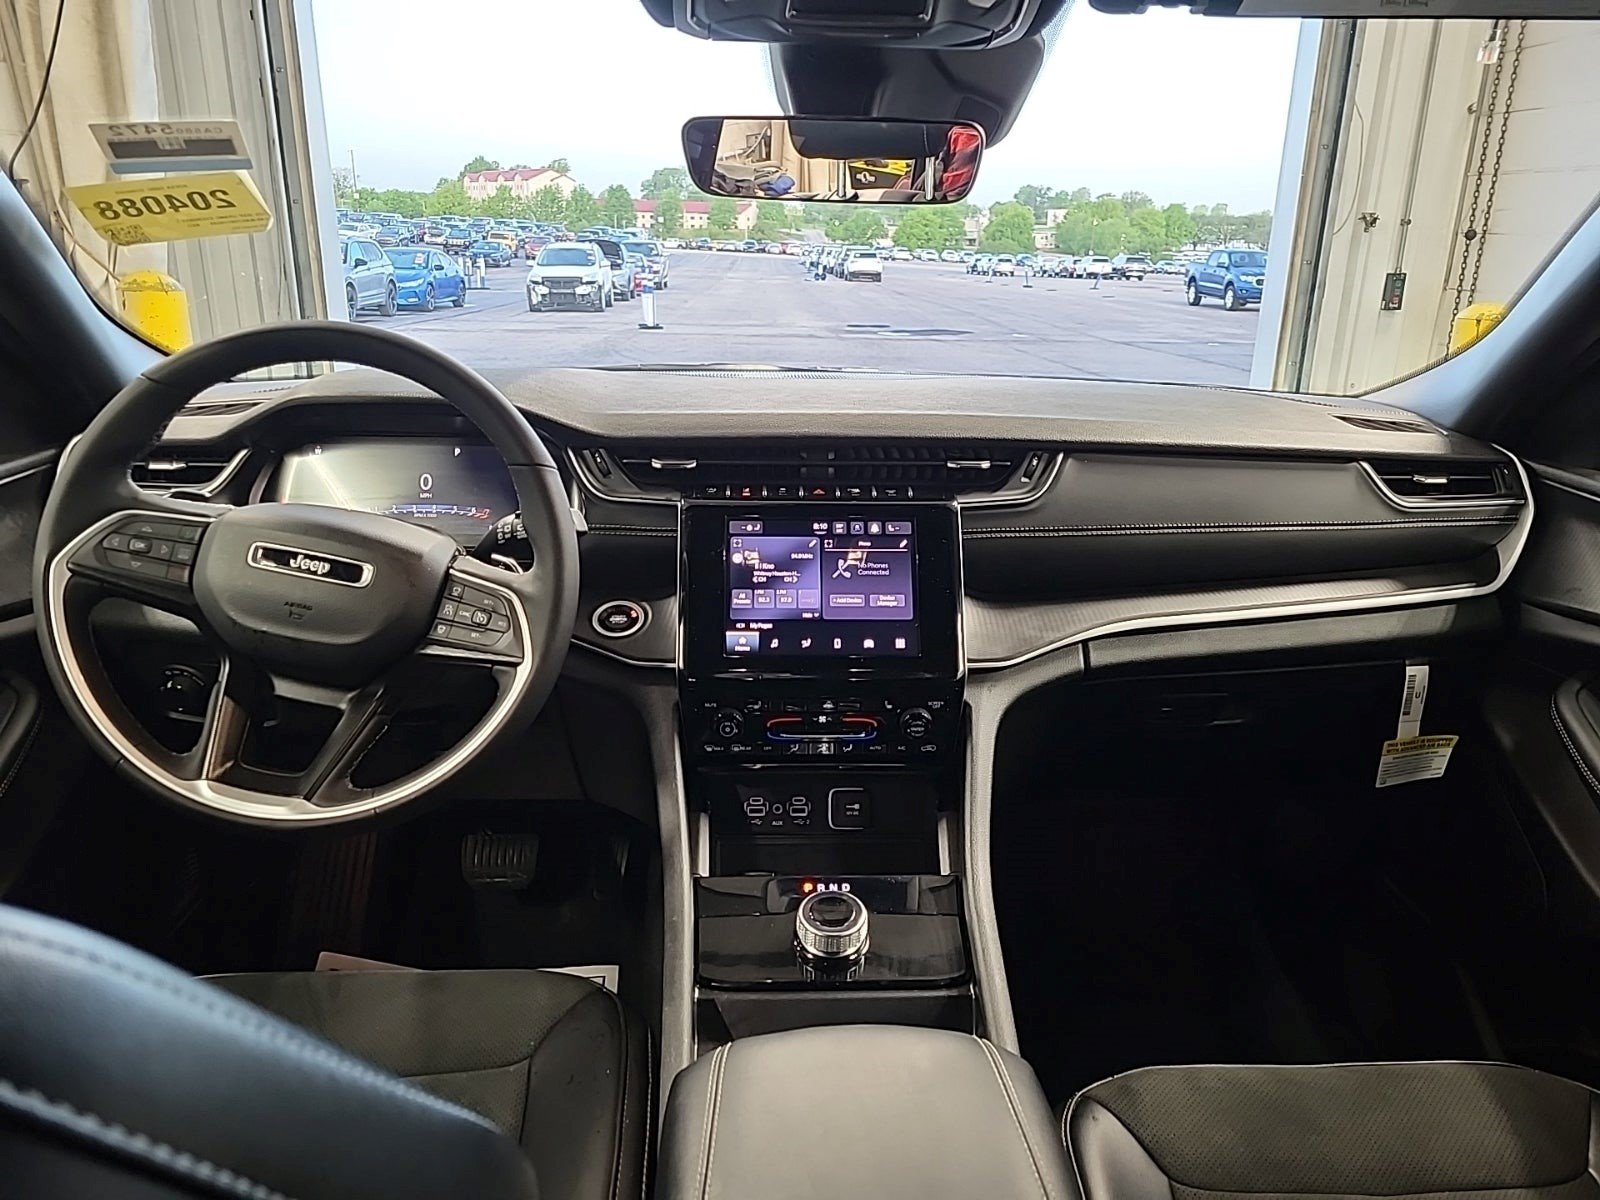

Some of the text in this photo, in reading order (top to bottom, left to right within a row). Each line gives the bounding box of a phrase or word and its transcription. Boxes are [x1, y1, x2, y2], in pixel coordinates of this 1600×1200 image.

[454, 447, 461, 457] P
[419, 473, 433, 491] 0
[289, 554, 331, 575] Jeep
[803, 882, 851, 893] P R N D
